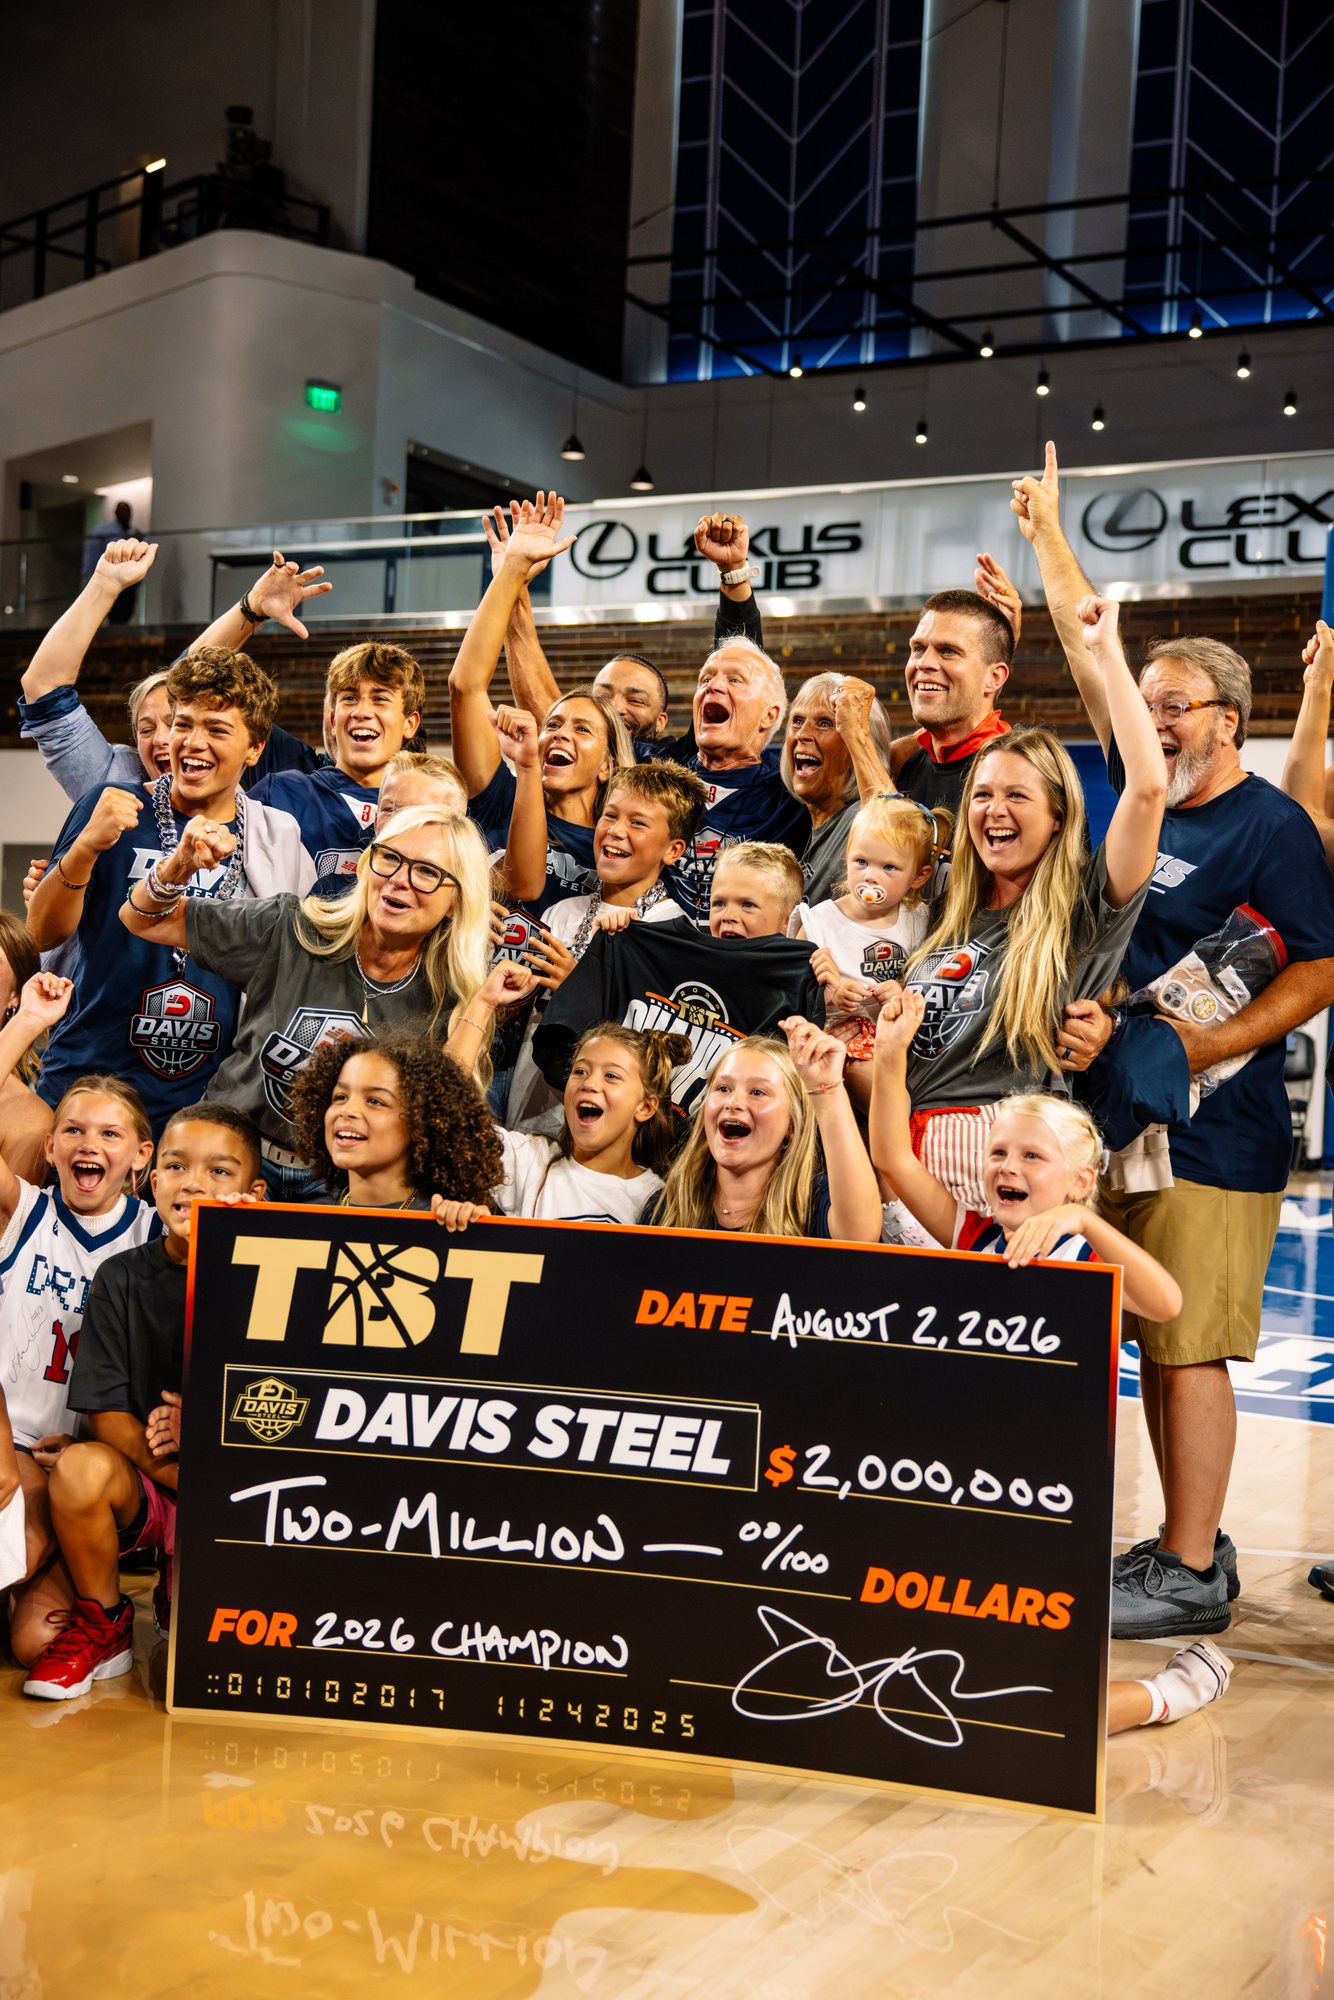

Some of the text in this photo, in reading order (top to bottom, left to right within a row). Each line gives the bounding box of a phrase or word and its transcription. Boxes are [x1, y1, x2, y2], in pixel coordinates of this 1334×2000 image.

[545, 864, 589, 895] SEEL
[863, 959, 906, 973] DAVIS
[135, 1017, 215, 1040] DAVIS
[677, 999, 721, 1030] TBT
[151, 1036, 198, 1049] STEEL
[231, 1235, 546, 1356] TBT
[635, 1289, 753, 1333] DATE
[771, 1292, 900, 1349] AUGUST
[243, 1400, 298, 1416] DAVIS
[314, 1387, 731, 1475] DAVIS STEEL
[859, 1566, 1075, 1630] DOLLARS
[207, 1607, 629, 1671] FOR 2026 CHAMPION
[497, 1696, 695, 1738] 11242025
